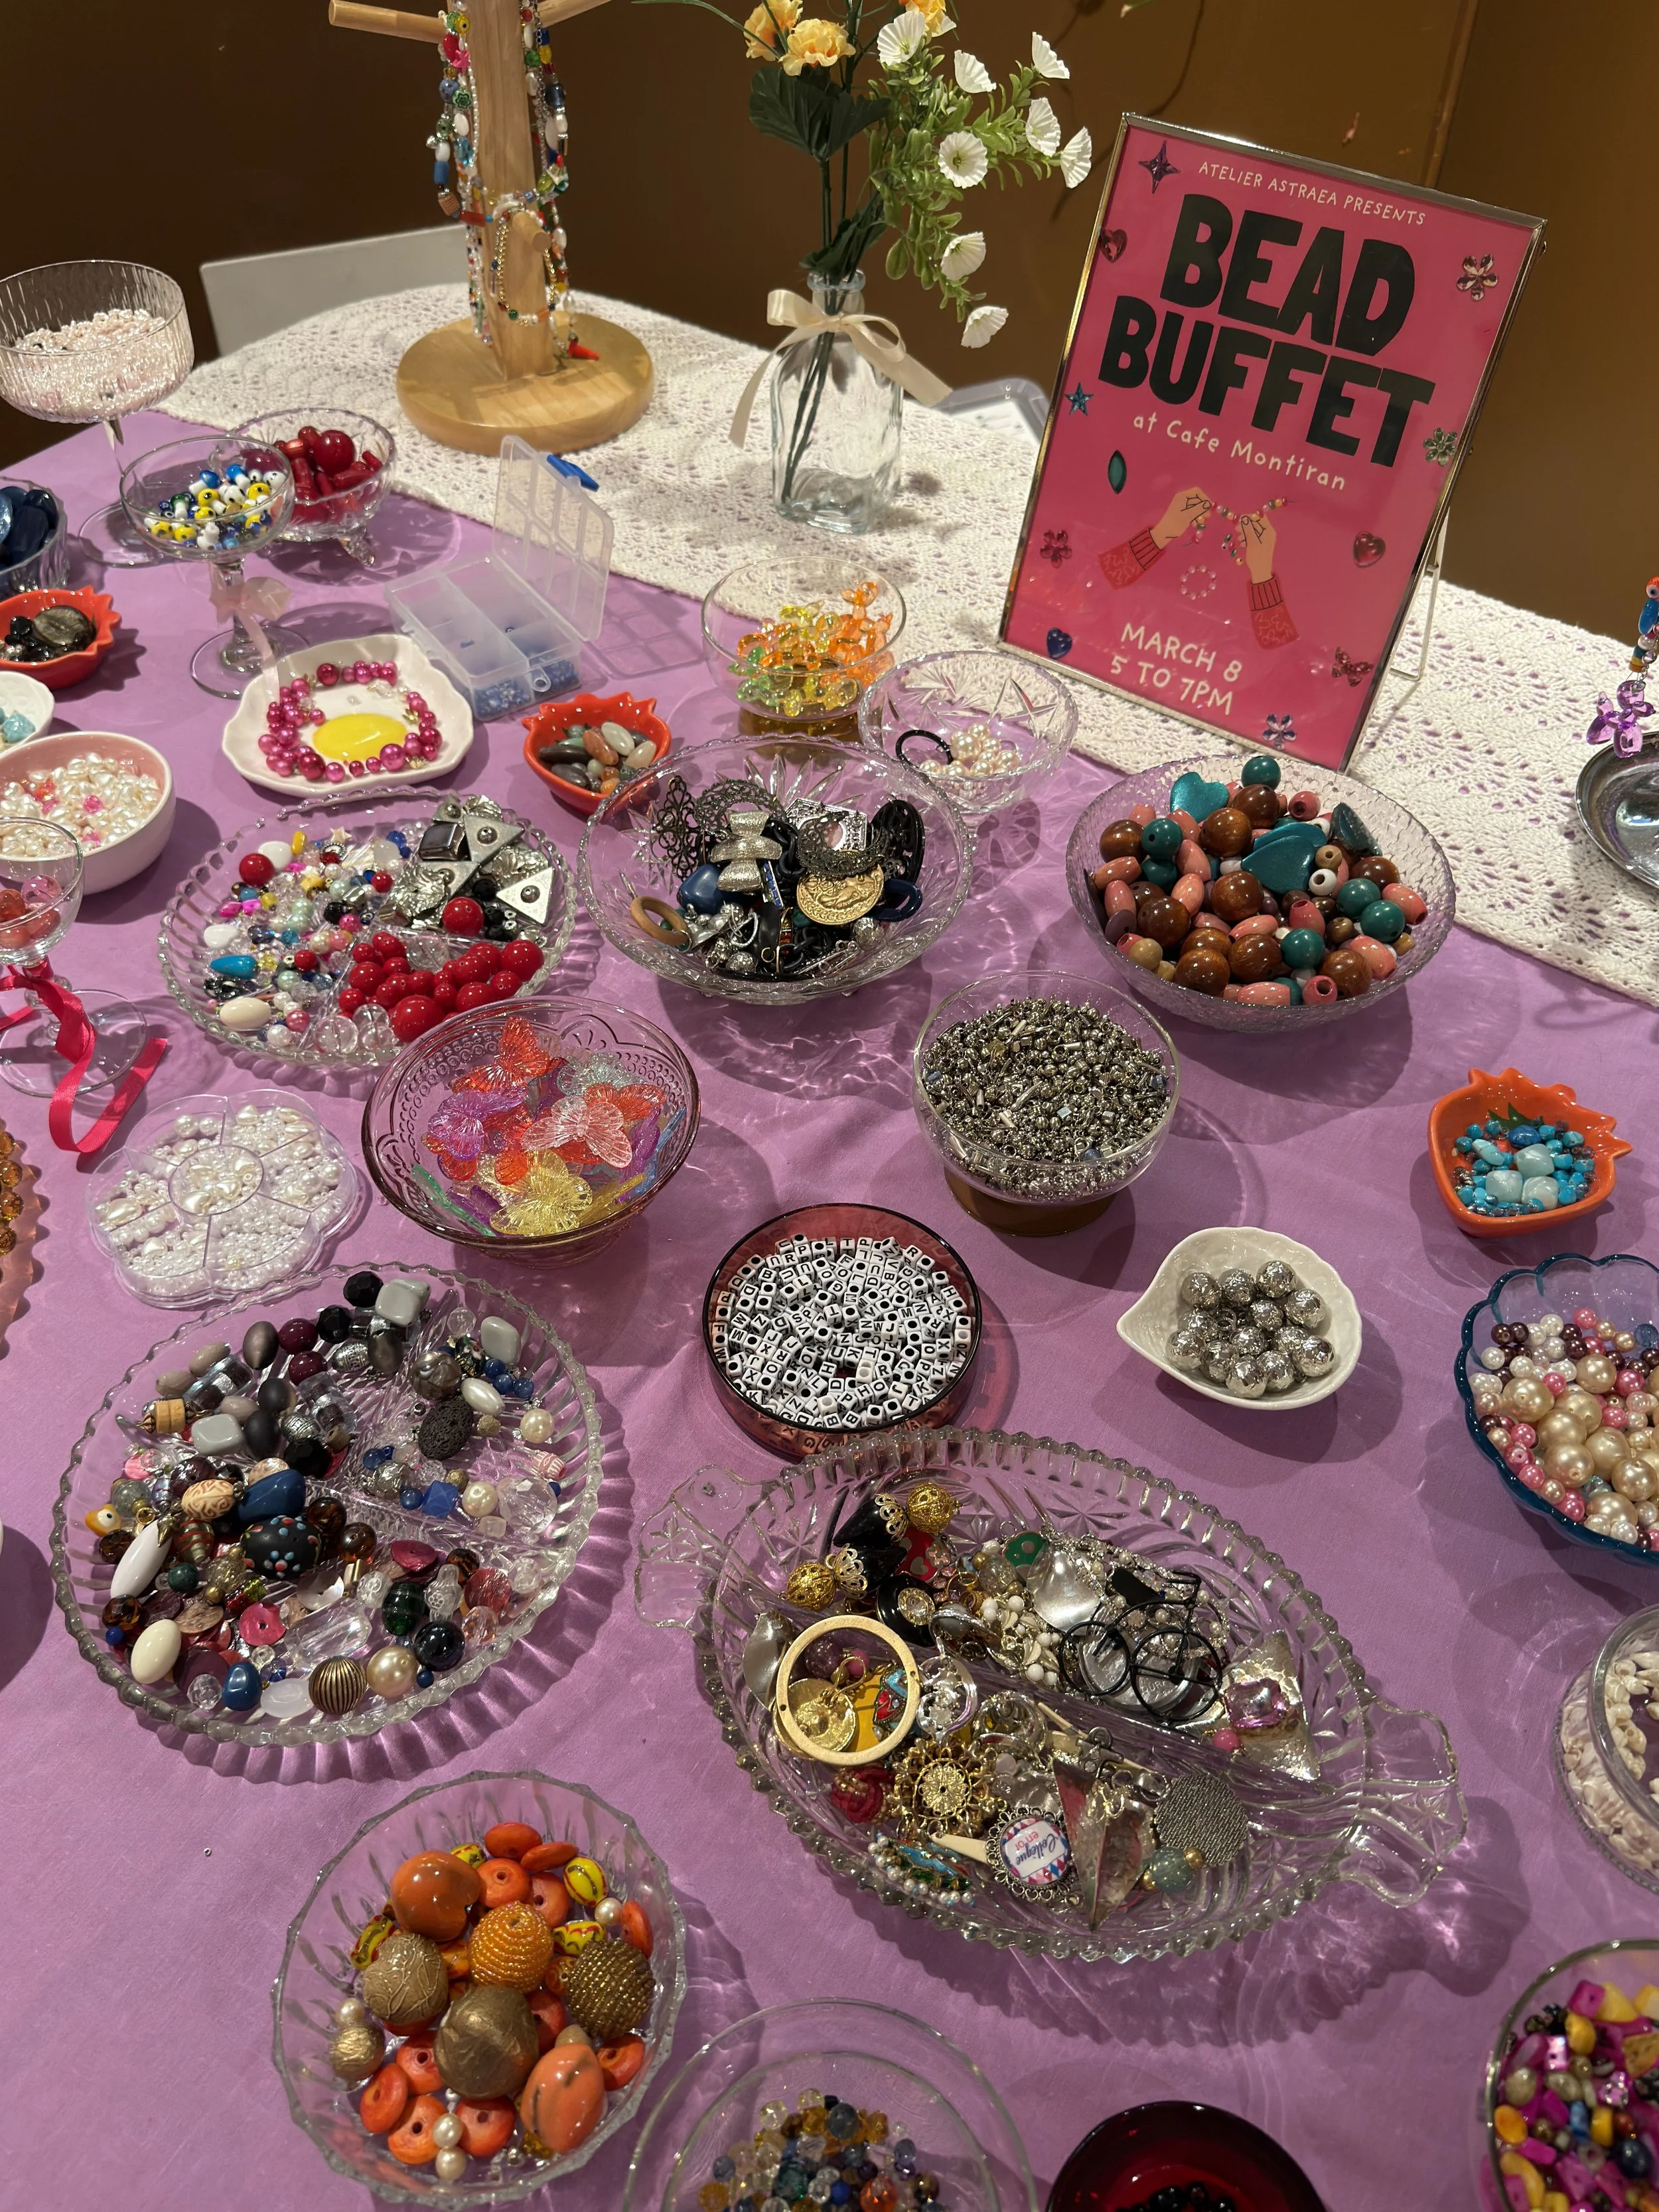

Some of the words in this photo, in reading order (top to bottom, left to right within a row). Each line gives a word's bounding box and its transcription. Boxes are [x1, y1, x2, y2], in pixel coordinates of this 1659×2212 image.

[1198, 161, 1263, 188] ATELIER
[1267, 178, 1337, 206] ASTRAEA
[1343, 195, 1426, 226] PRESENTS
[1159, 193, 1415, 357] BEAD
[1098, 295, 1437, 467] BUFFET
[1133, 411, 1157, 433] at
[1167, 419, 1220, 453] Cafe
[1230, 439, 1345, 491] Montiran
[1120, 623, 1216, 673] MARCH
[1223, 660, 1242, 682] 8
[1110, 654, 1128, 675] 5
[1137, 661, 1171, 688] TO
[1180, 677, 1232, 716] 7PM
[798, 1246, 806, 1254] P
[907, 1247, 918, 1257] R
[785, 1254, 795, 1263] R
[762, 1270, 773, 1279] B
[732, 1278, 743, 1287] D
[867, 1277, 878, 1286] D
[899, 1281, 910, 1290] D
[744, 1286, 755, 1295] D
[944, 1288, 956, 1297] H
[931, 1294, 940, 1303] A
[865, 1307, 875, 1317] V
[901, 1308, 912, 1317] M
[943, 1309, 954, 1321] X
[775, 1317, 786, 1327] D
[792, 1313, 802, 1323] S
[886, 1323, 894, 1332] J
[930, 1319, 942, 1329] R
[760, 1344, 771, 1355] X
[831, 1347, 843, 1357] U
[847, 1349, 860, 1359] K
[865, 1350, 877, 1359] T
[776, 1351, 788, 1361] R
[802, 1354, 812, 1364] O
[766, 1364, 778, 1373] O
[822, 1364, 834, 1374] H
[878, 1365, 889, 1376] R
[920, 1362, 931, 1370] P
[746, 1370, 758, 1381] X
[831, 1380, 841, 1389] D
[874, 1382, 885, 1391] O
[893, 1384, 902, 1394] J
[916, 1380, 929, 1392] K
[857, 1386, 870, 1396] H
[841, 1392, 853, 1402] P
[908, 1396, 918, 1406] T
[827, 1416, 839, 1426] B
[846, 1414, 859, 1424] B
[1025, 1831, 1039, 1842] en
[1015, 1840, 1025, 1851] or
